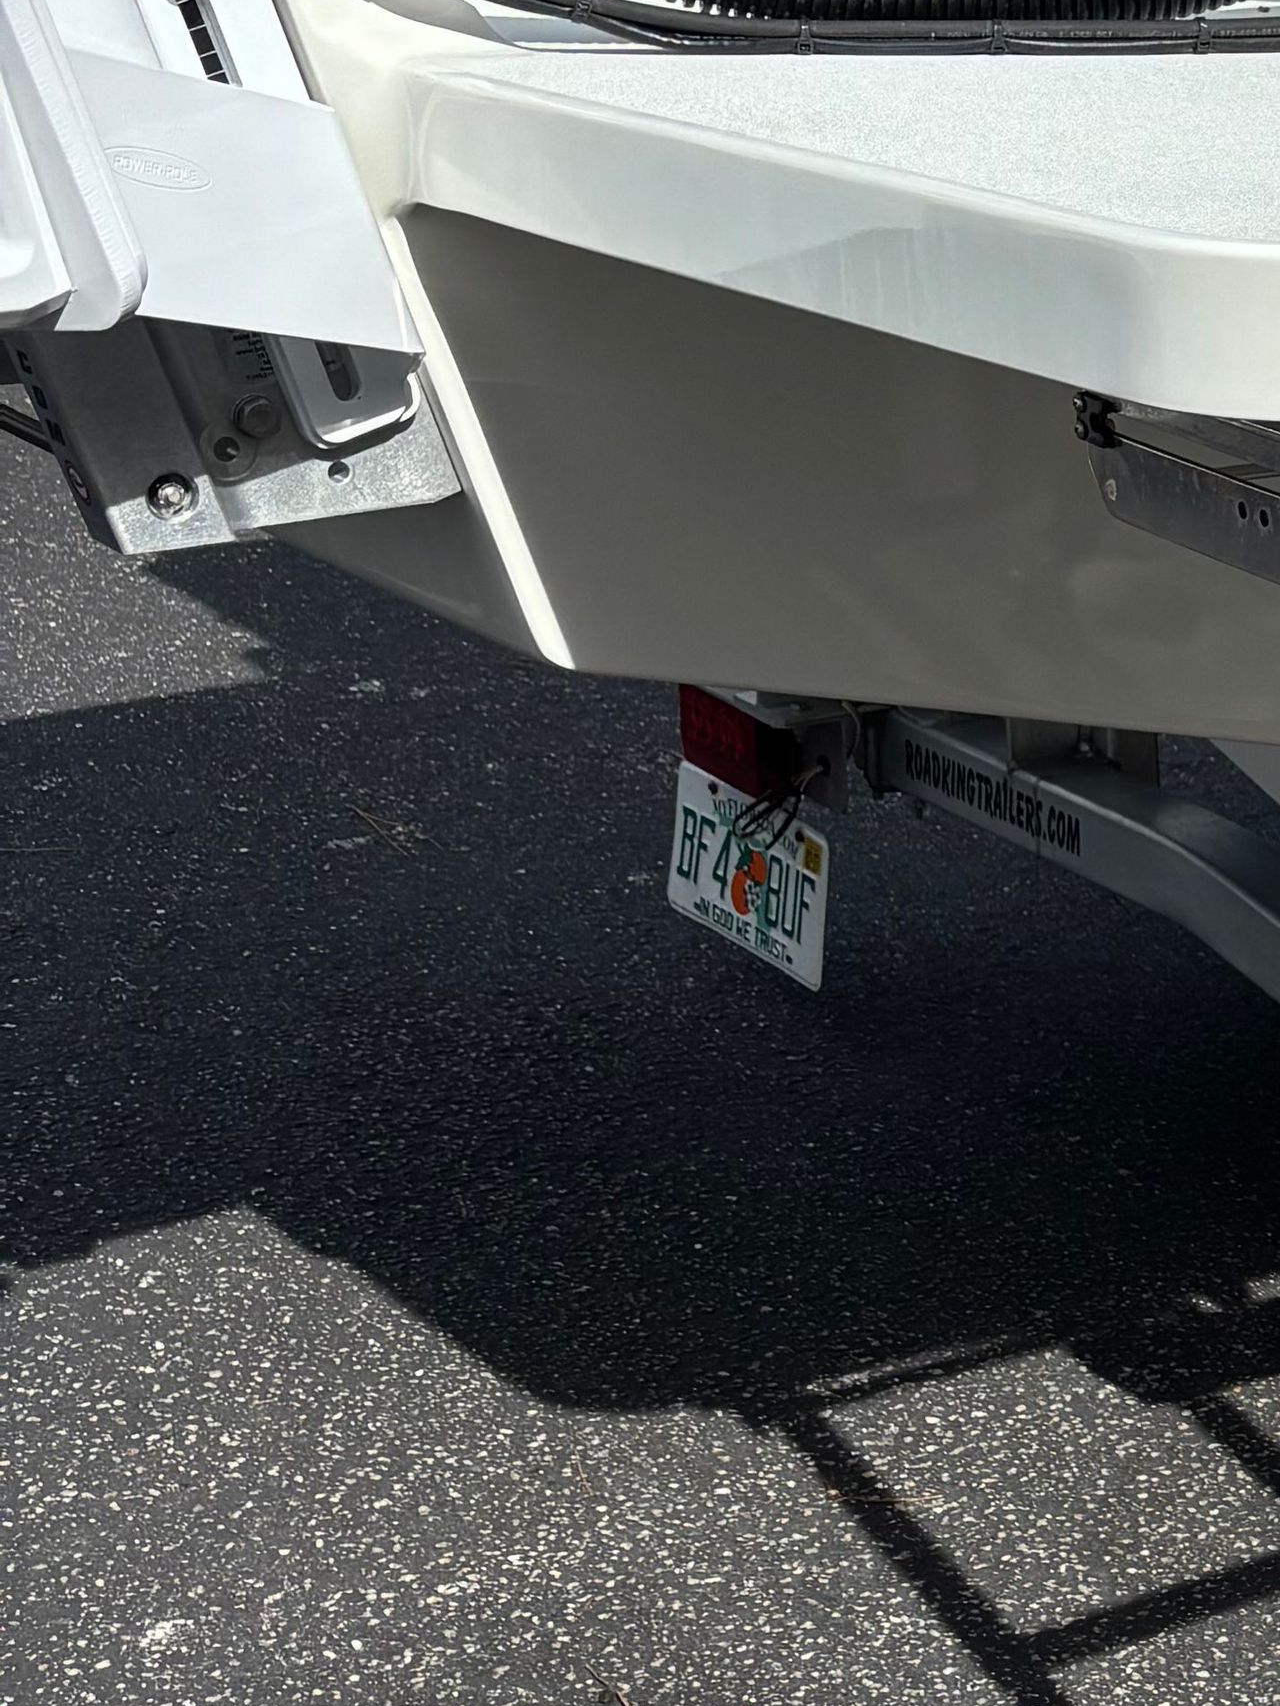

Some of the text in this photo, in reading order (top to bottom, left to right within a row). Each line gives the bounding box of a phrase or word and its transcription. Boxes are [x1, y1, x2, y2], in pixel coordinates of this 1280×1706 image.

[904, 739, 1081, 857] ROADKINGTRAILERS.COM
[713, 905, 733, 931] GOD
[736, 918, 751, 942] WE
[754, 926, 788, 962] TRUST
